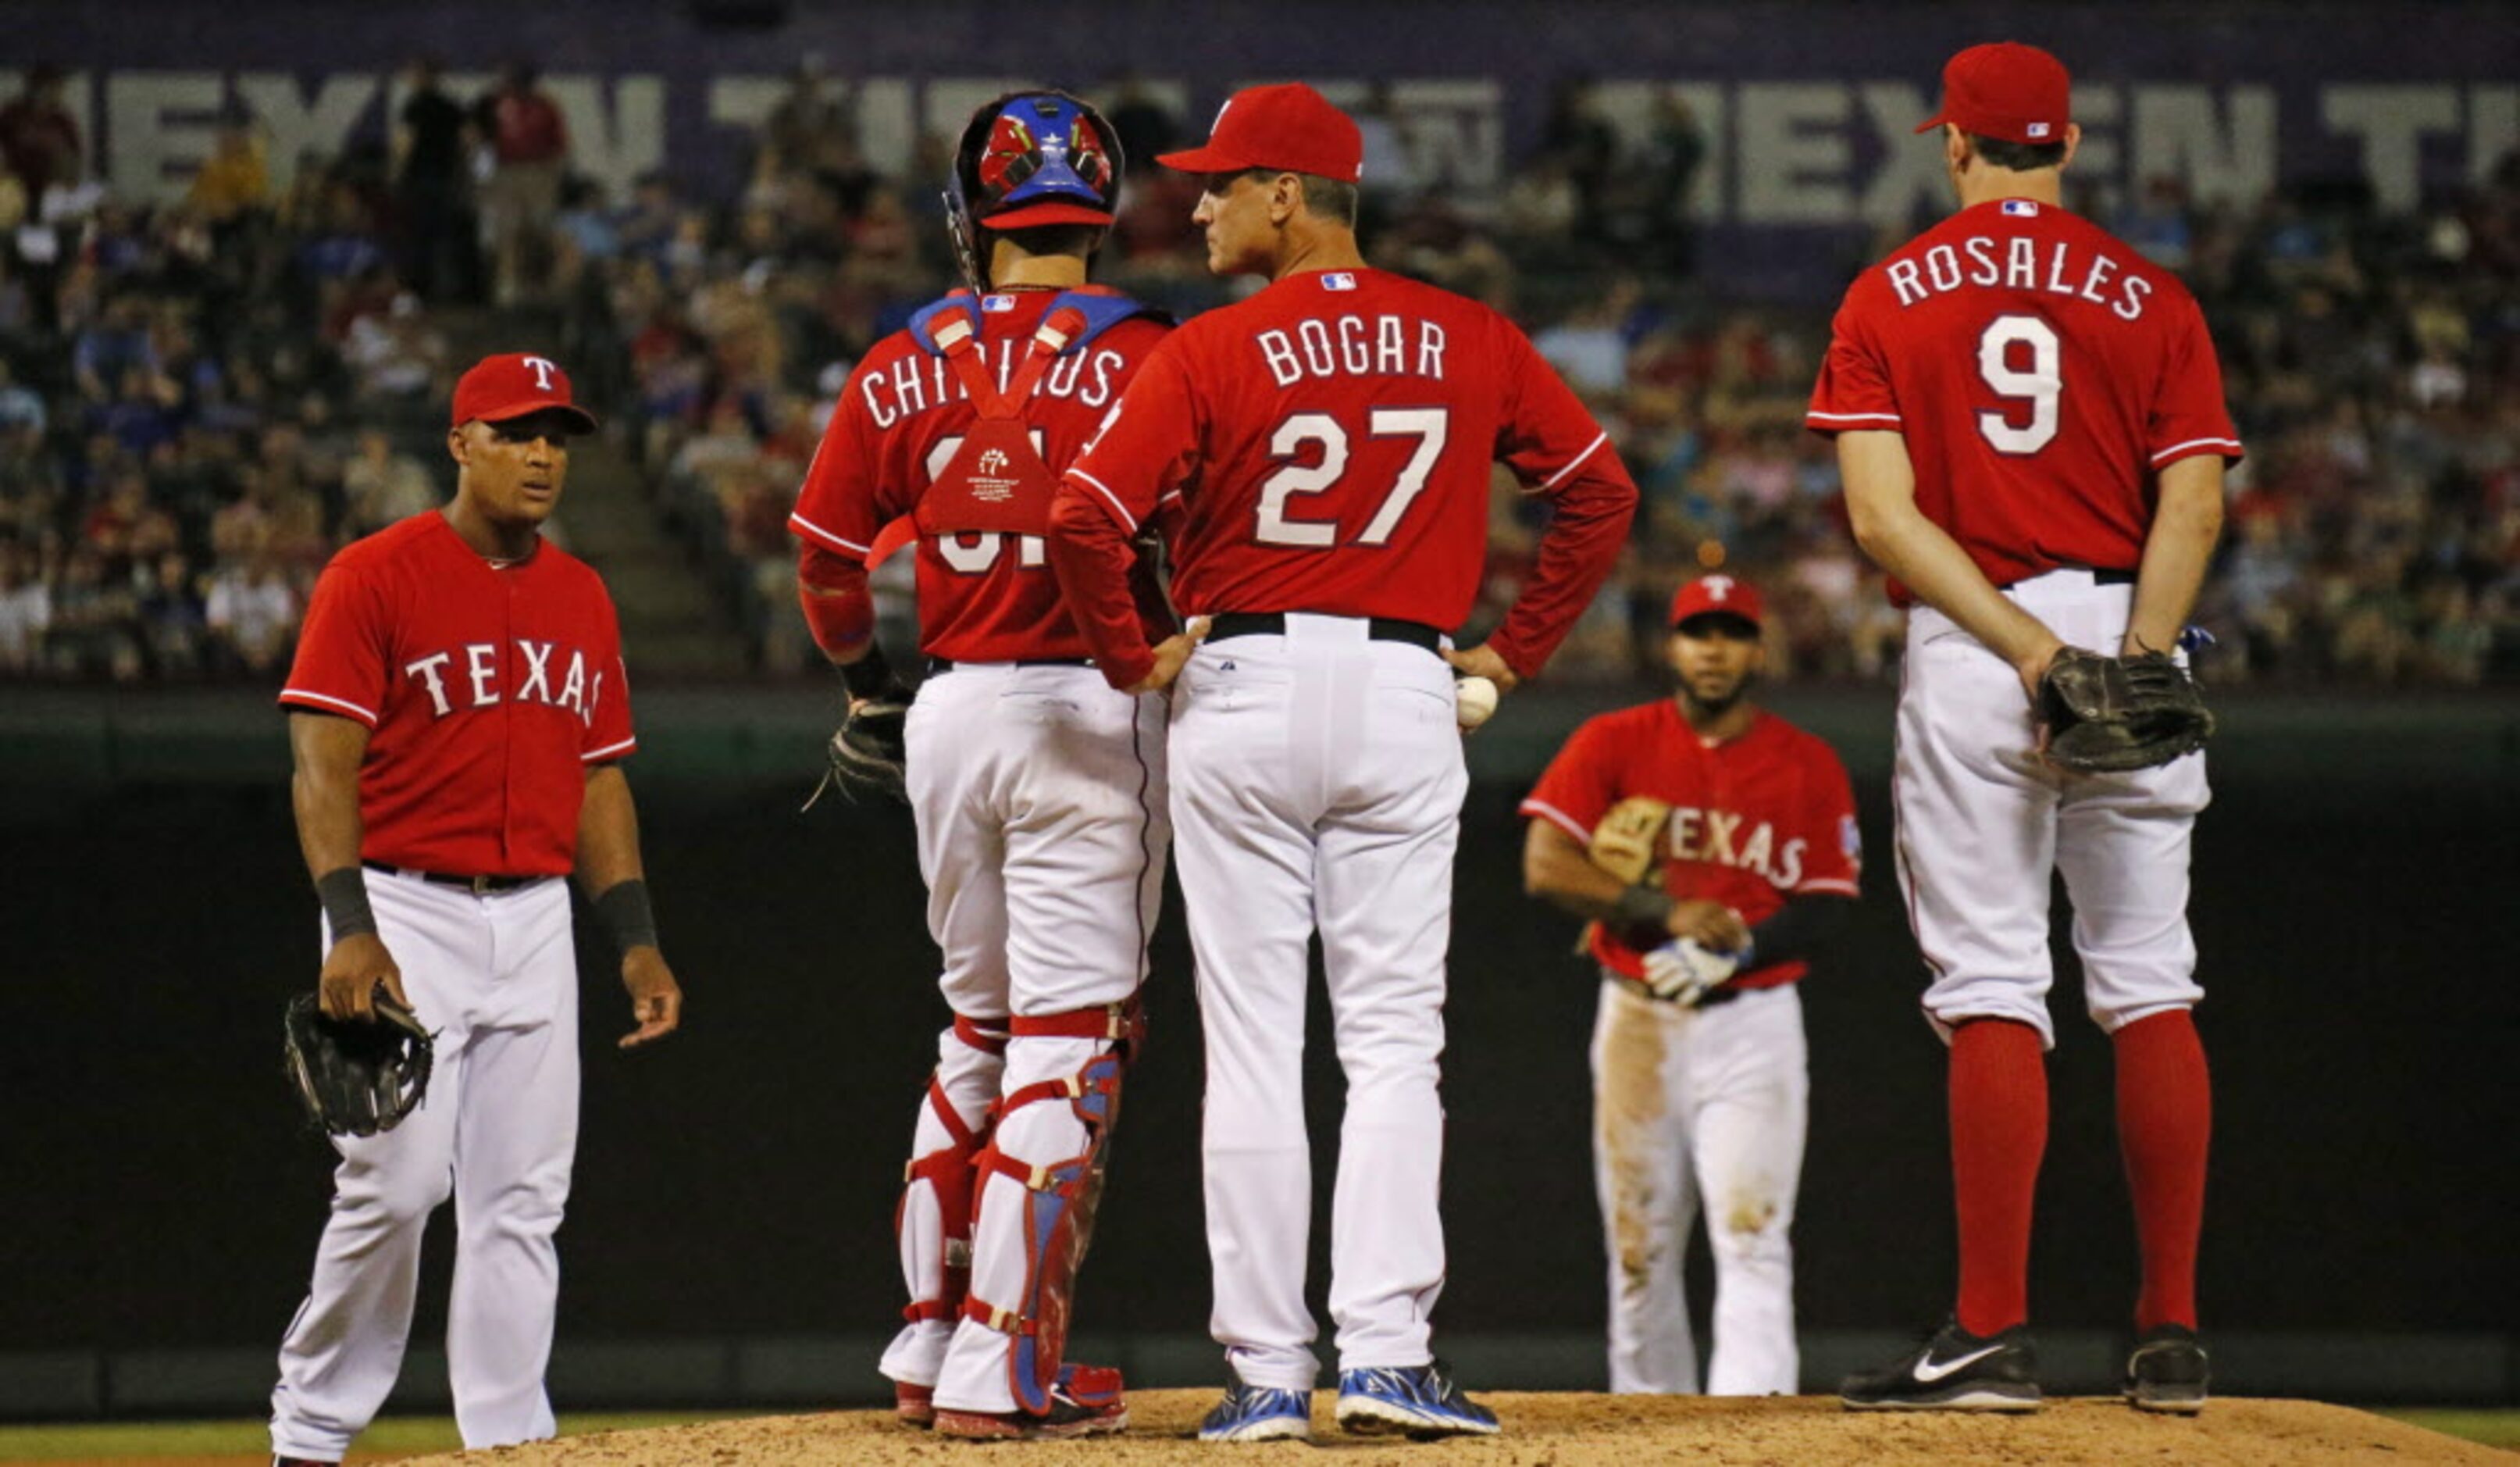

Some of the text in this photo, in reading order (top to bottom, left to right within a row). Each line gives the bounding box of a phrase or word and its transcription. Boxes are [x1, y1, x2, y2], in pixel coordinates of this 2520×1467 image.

[0, 73, 666, 209] EXN
[1887, 237, 2151, 320] ROSALES
[523, 357, 554, 391] T
[1257, 316, 1445, 386] BOGAR
[1978, 315, 2062, 455] 9
[1256, 408, 1448, 545] 27
[1701, 575, 1734, 601] T
[1670, 806, 1807, 889] EXAS
